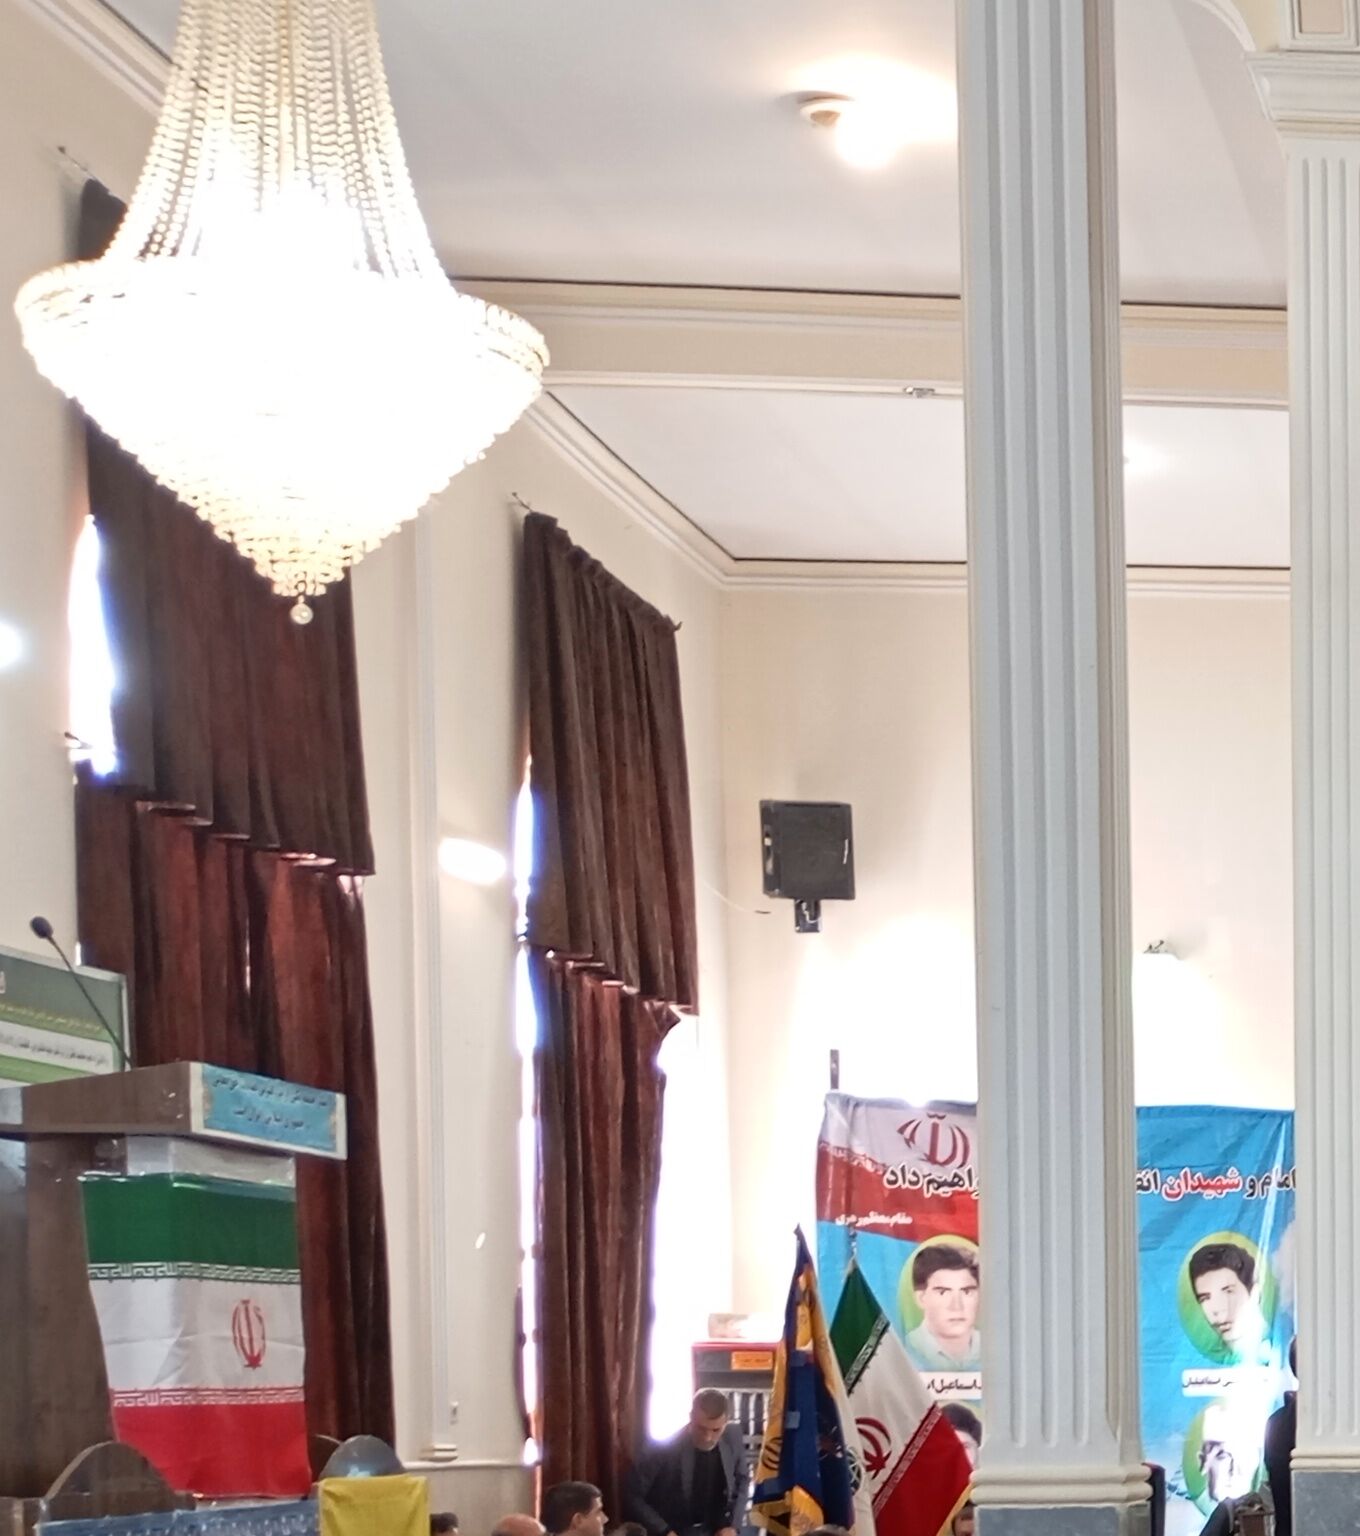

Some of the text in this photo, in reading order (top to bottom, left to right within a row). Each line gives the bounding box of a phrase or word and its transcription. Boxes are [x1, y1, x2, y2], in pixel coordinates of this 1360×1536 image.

[883, 1163, 921, 1188] داد
[1162, 1167, 1243, 1201] شهیدان
[1245, 1174, 1258, 1199] و
